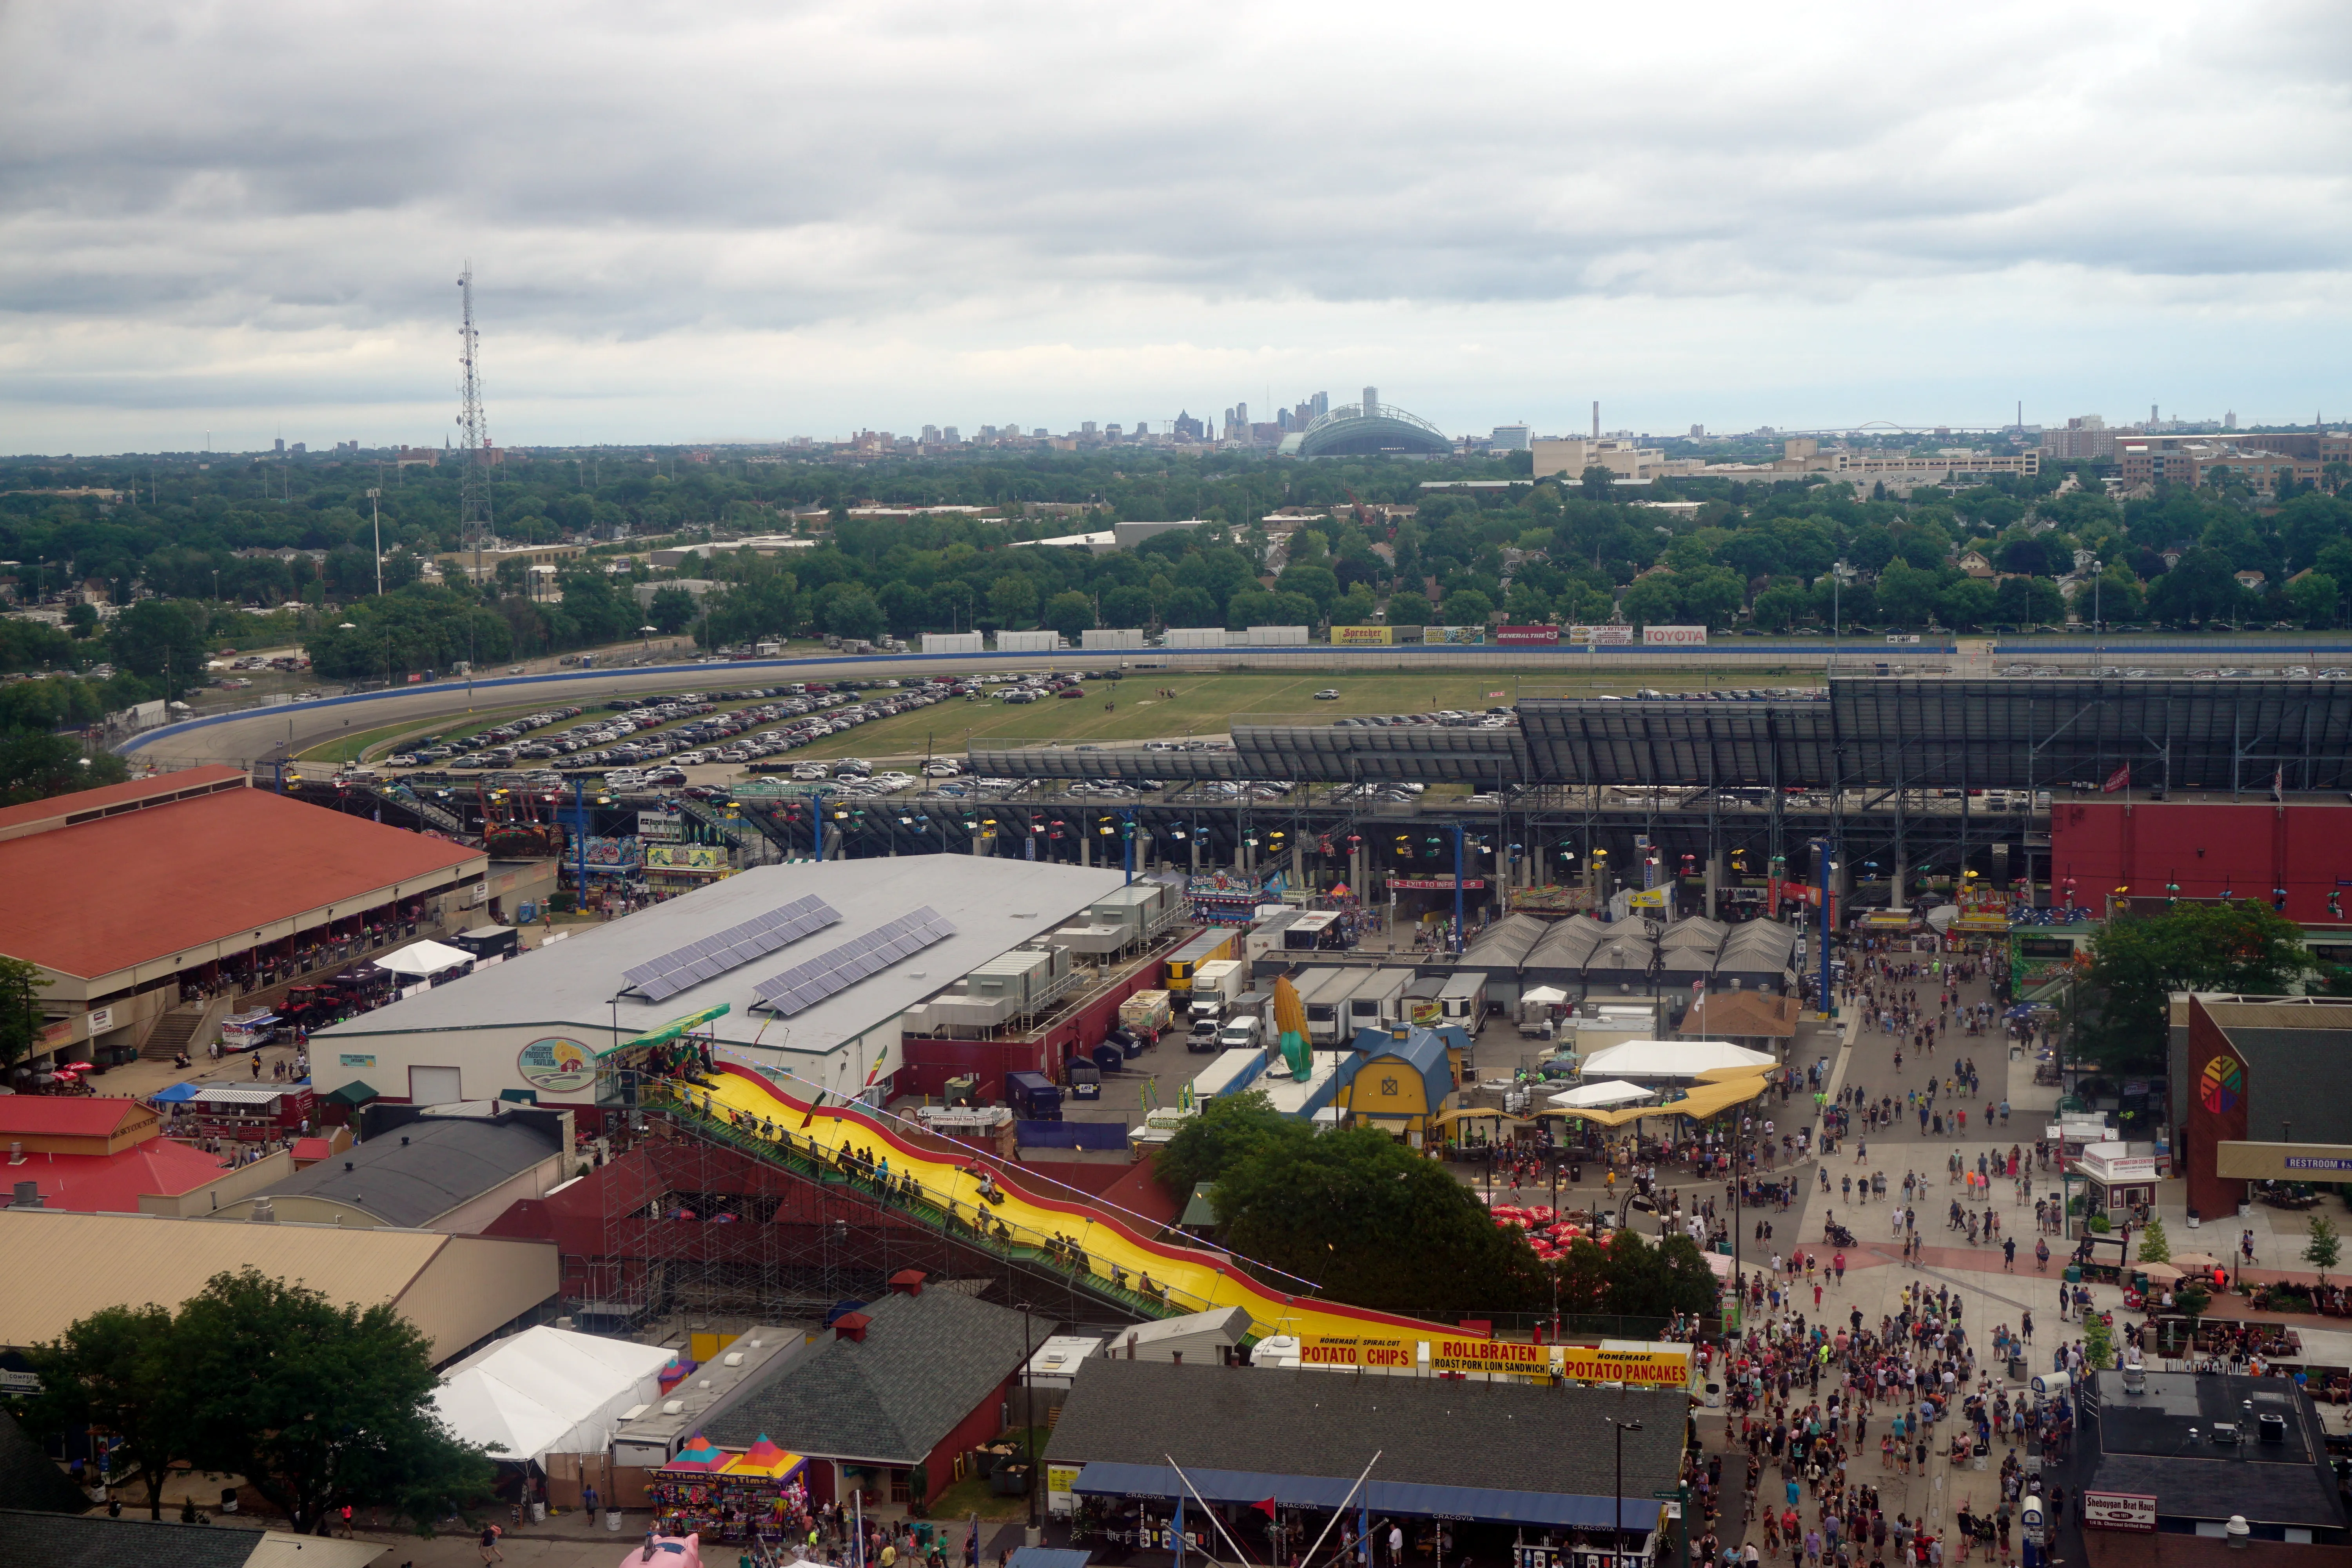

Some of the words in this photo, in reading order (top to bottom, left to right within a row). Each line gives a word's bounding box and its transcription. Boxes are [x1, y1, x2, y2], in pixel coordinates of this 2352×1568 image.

[1343, 628, 1381, 639] Sprecher
[1646, 630, 1705, 641] TOYOTA
[1192, 876, 1217, 887] Shrimp
[1227, 877, 1250, 891] Shack
[224, 1024, 242, 1033] Coors
[121, 1127, 131, 1136] SKY
[130, 1116, 157, 1133] COUNTRY
[2290, 1159, 2338, 1168] RESTROOM
[1302, 1347, 1356, 1363] POTATO
[1367, 1349, 1409, 1365] CHIPS
[1443, 1342, 1536, 1361] ROLLBRATEN
[1432, 1358, 1459, 1368] (ROAST
[1462, 1360, 1482, 1369] PORK
[1485, 1361, 1503, 1370] LOIN
[1505, 1362, 1548, 1374] SANDWICH)
[1566, 1361, 1622, 1379] POTATO
[1626, 1365, 1686, 1381] PANCAKES
[650, 1472, 673, 1480] Toy
[713, 1475, 736, 1485] Toy
[2087, 1497, 2121, 1509] Sheboygan
[2123, 1499, 2136, 1510] Brat
[2138, 1501, 2154, 1511] Haus
[1107, 1528, 1120, 1541] Lite
